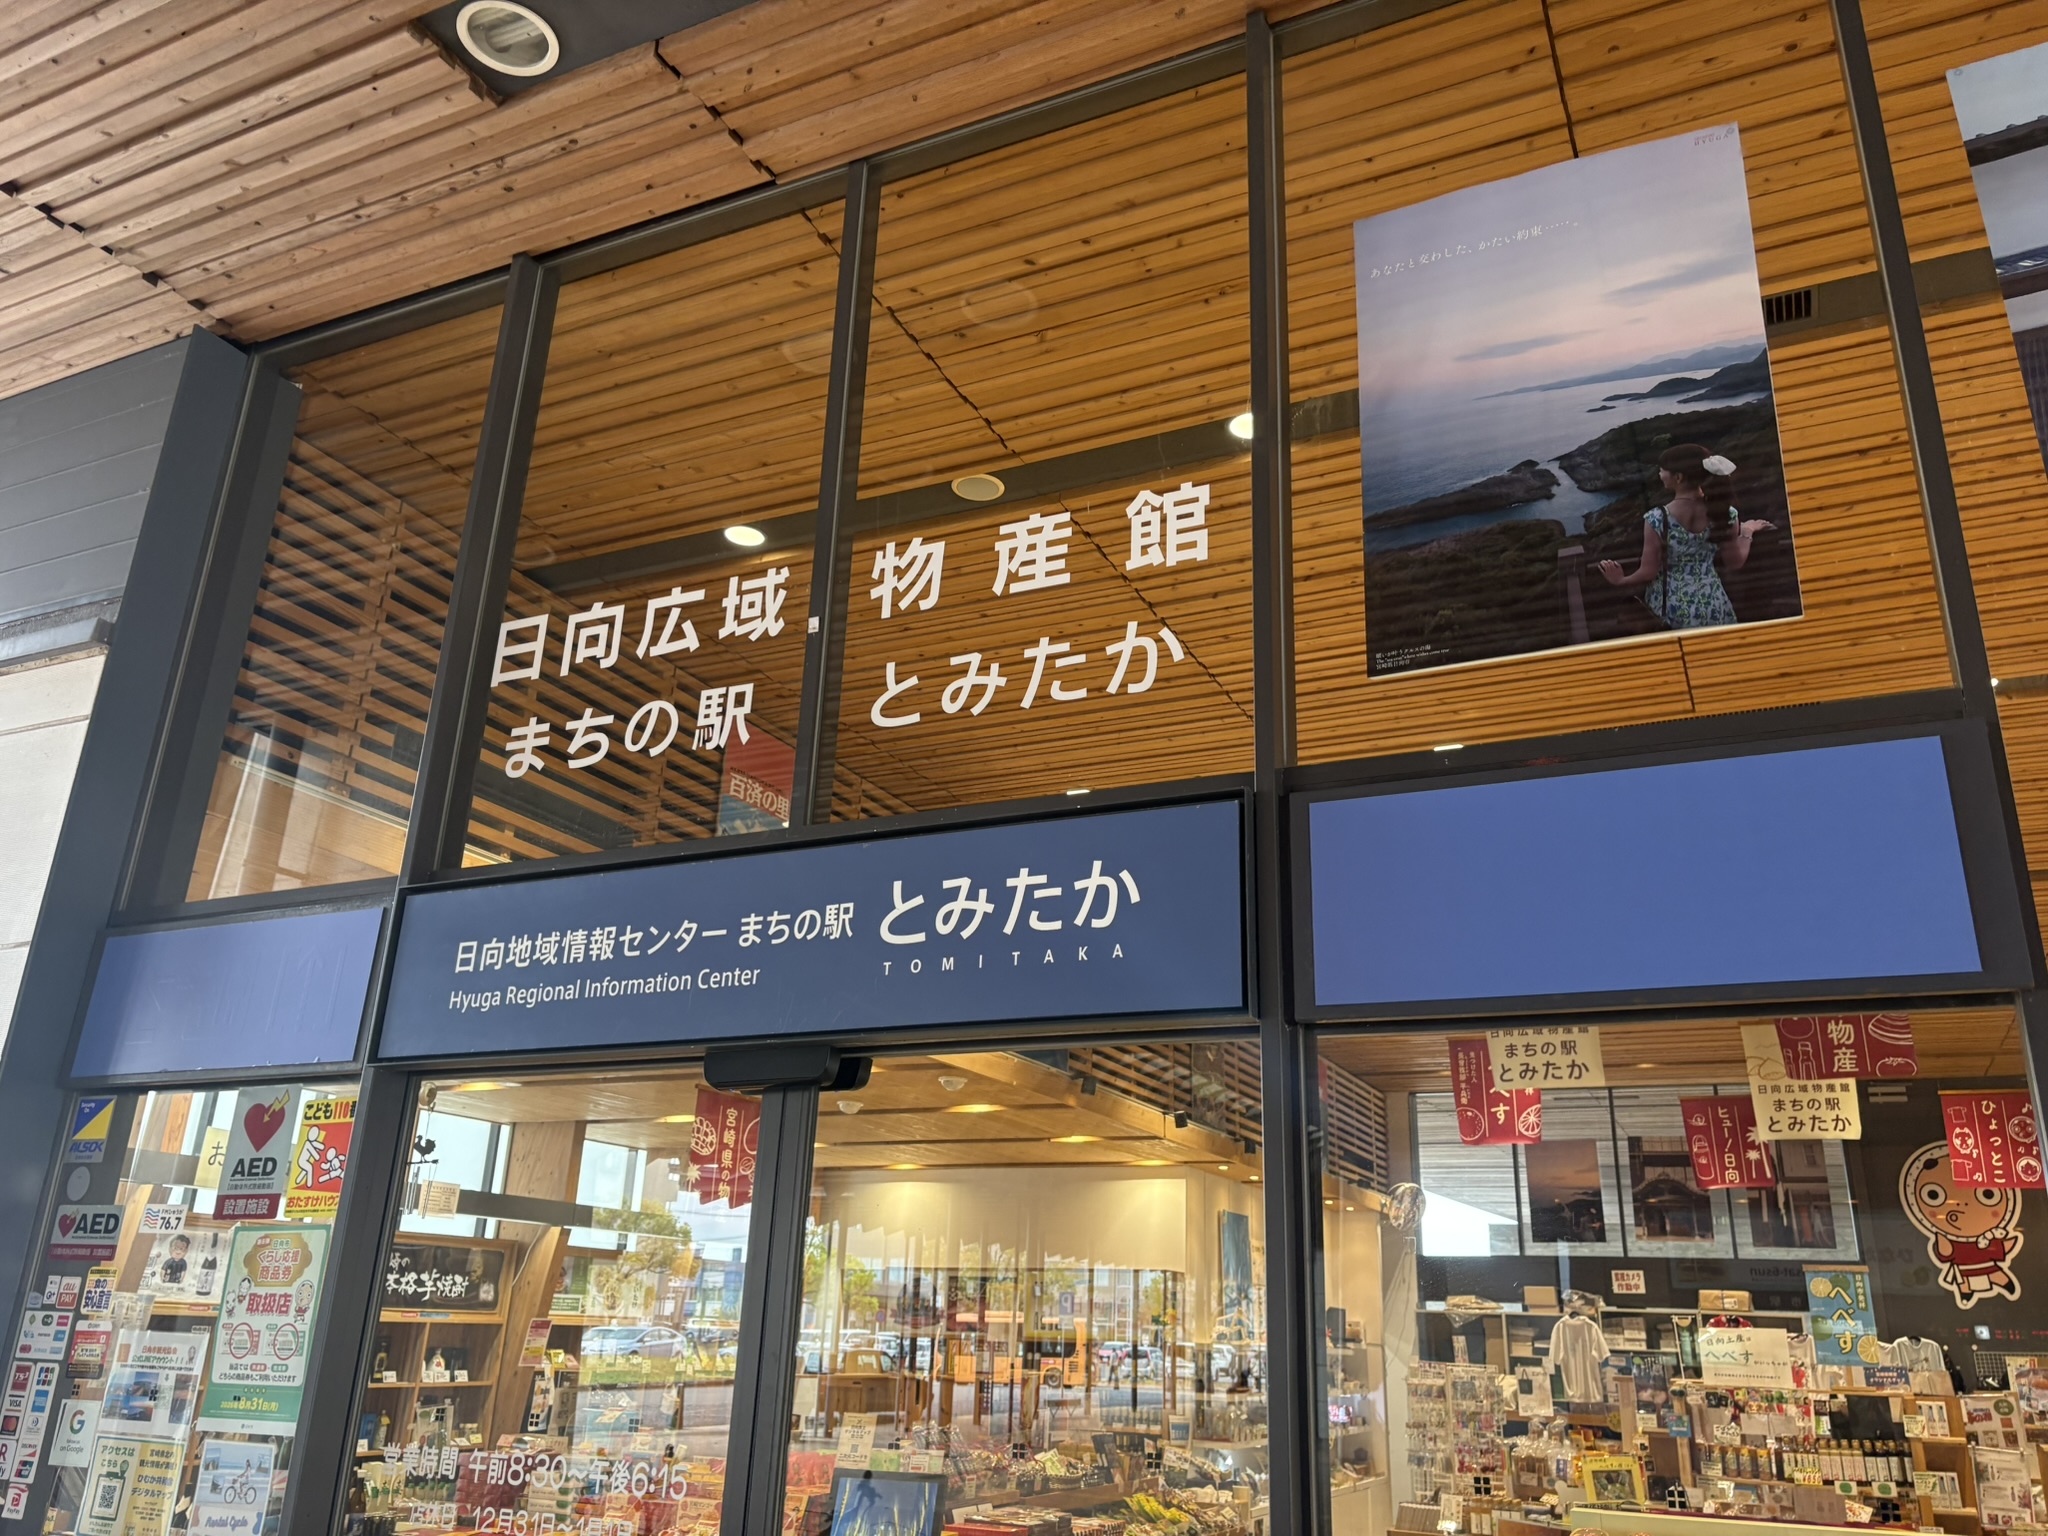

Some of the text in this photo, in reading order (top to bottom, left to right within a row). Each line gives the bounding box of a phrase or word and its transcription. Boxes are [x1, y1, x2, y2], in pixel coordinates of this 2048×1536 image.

[490, 481, 1210, 688] 日向広域 物産館
[504, 621, 1185, 779] まちの駅 とみたか
[730, 772, 789, 822] 百済の里
[454, 859, 1141, 975] 日向地域情報センター まちの駅 とみたか
[448, 964, 761, 1014] Hyuga Regional Information Center
[1504, 1039, 1578, 1059] まちの駅
[1499, 1059, 1590, 1083] とみたか
[1758, 1082, 1851, 1095] 日向広域物産館
[1772, 1097, 1841, 1112] まちの駅
[1767, 1114, 1852, 1133] とみたか
[69, 1141, 104, 1153] ALSOK
[1981, 1100, 2006, 1183] ひょっとこ
[230, 1157, 278, 1178] AED
[222, 1198, 270, 1215] 設置施設
[73, 1213, 120, 1234] AED
[159, 1216, 182, 1230] 76.7
[257, 1249, 301, 1264] くらし応援
[258, 1265, 292, 1280] 商品券
[63, 1282, 77, 1291] au
[61, 1294, 73, 1303] PAY
[246, 1292, 292, 1315] 取扱店
[1828, 1286, 1857, 1354] へべす
[1705, 1350, 1754, 1365] へべす
[38, 1372, 53, 1380] JCB
[9, 1399, 22, 1408] VISA
[67, 1445, 84, 1453] Google
[101, 1445, 135, 1456] アクセスは
[101, 1459, 118, 1468] こちら
[381, 1442, 459, 1480] 営業時間
